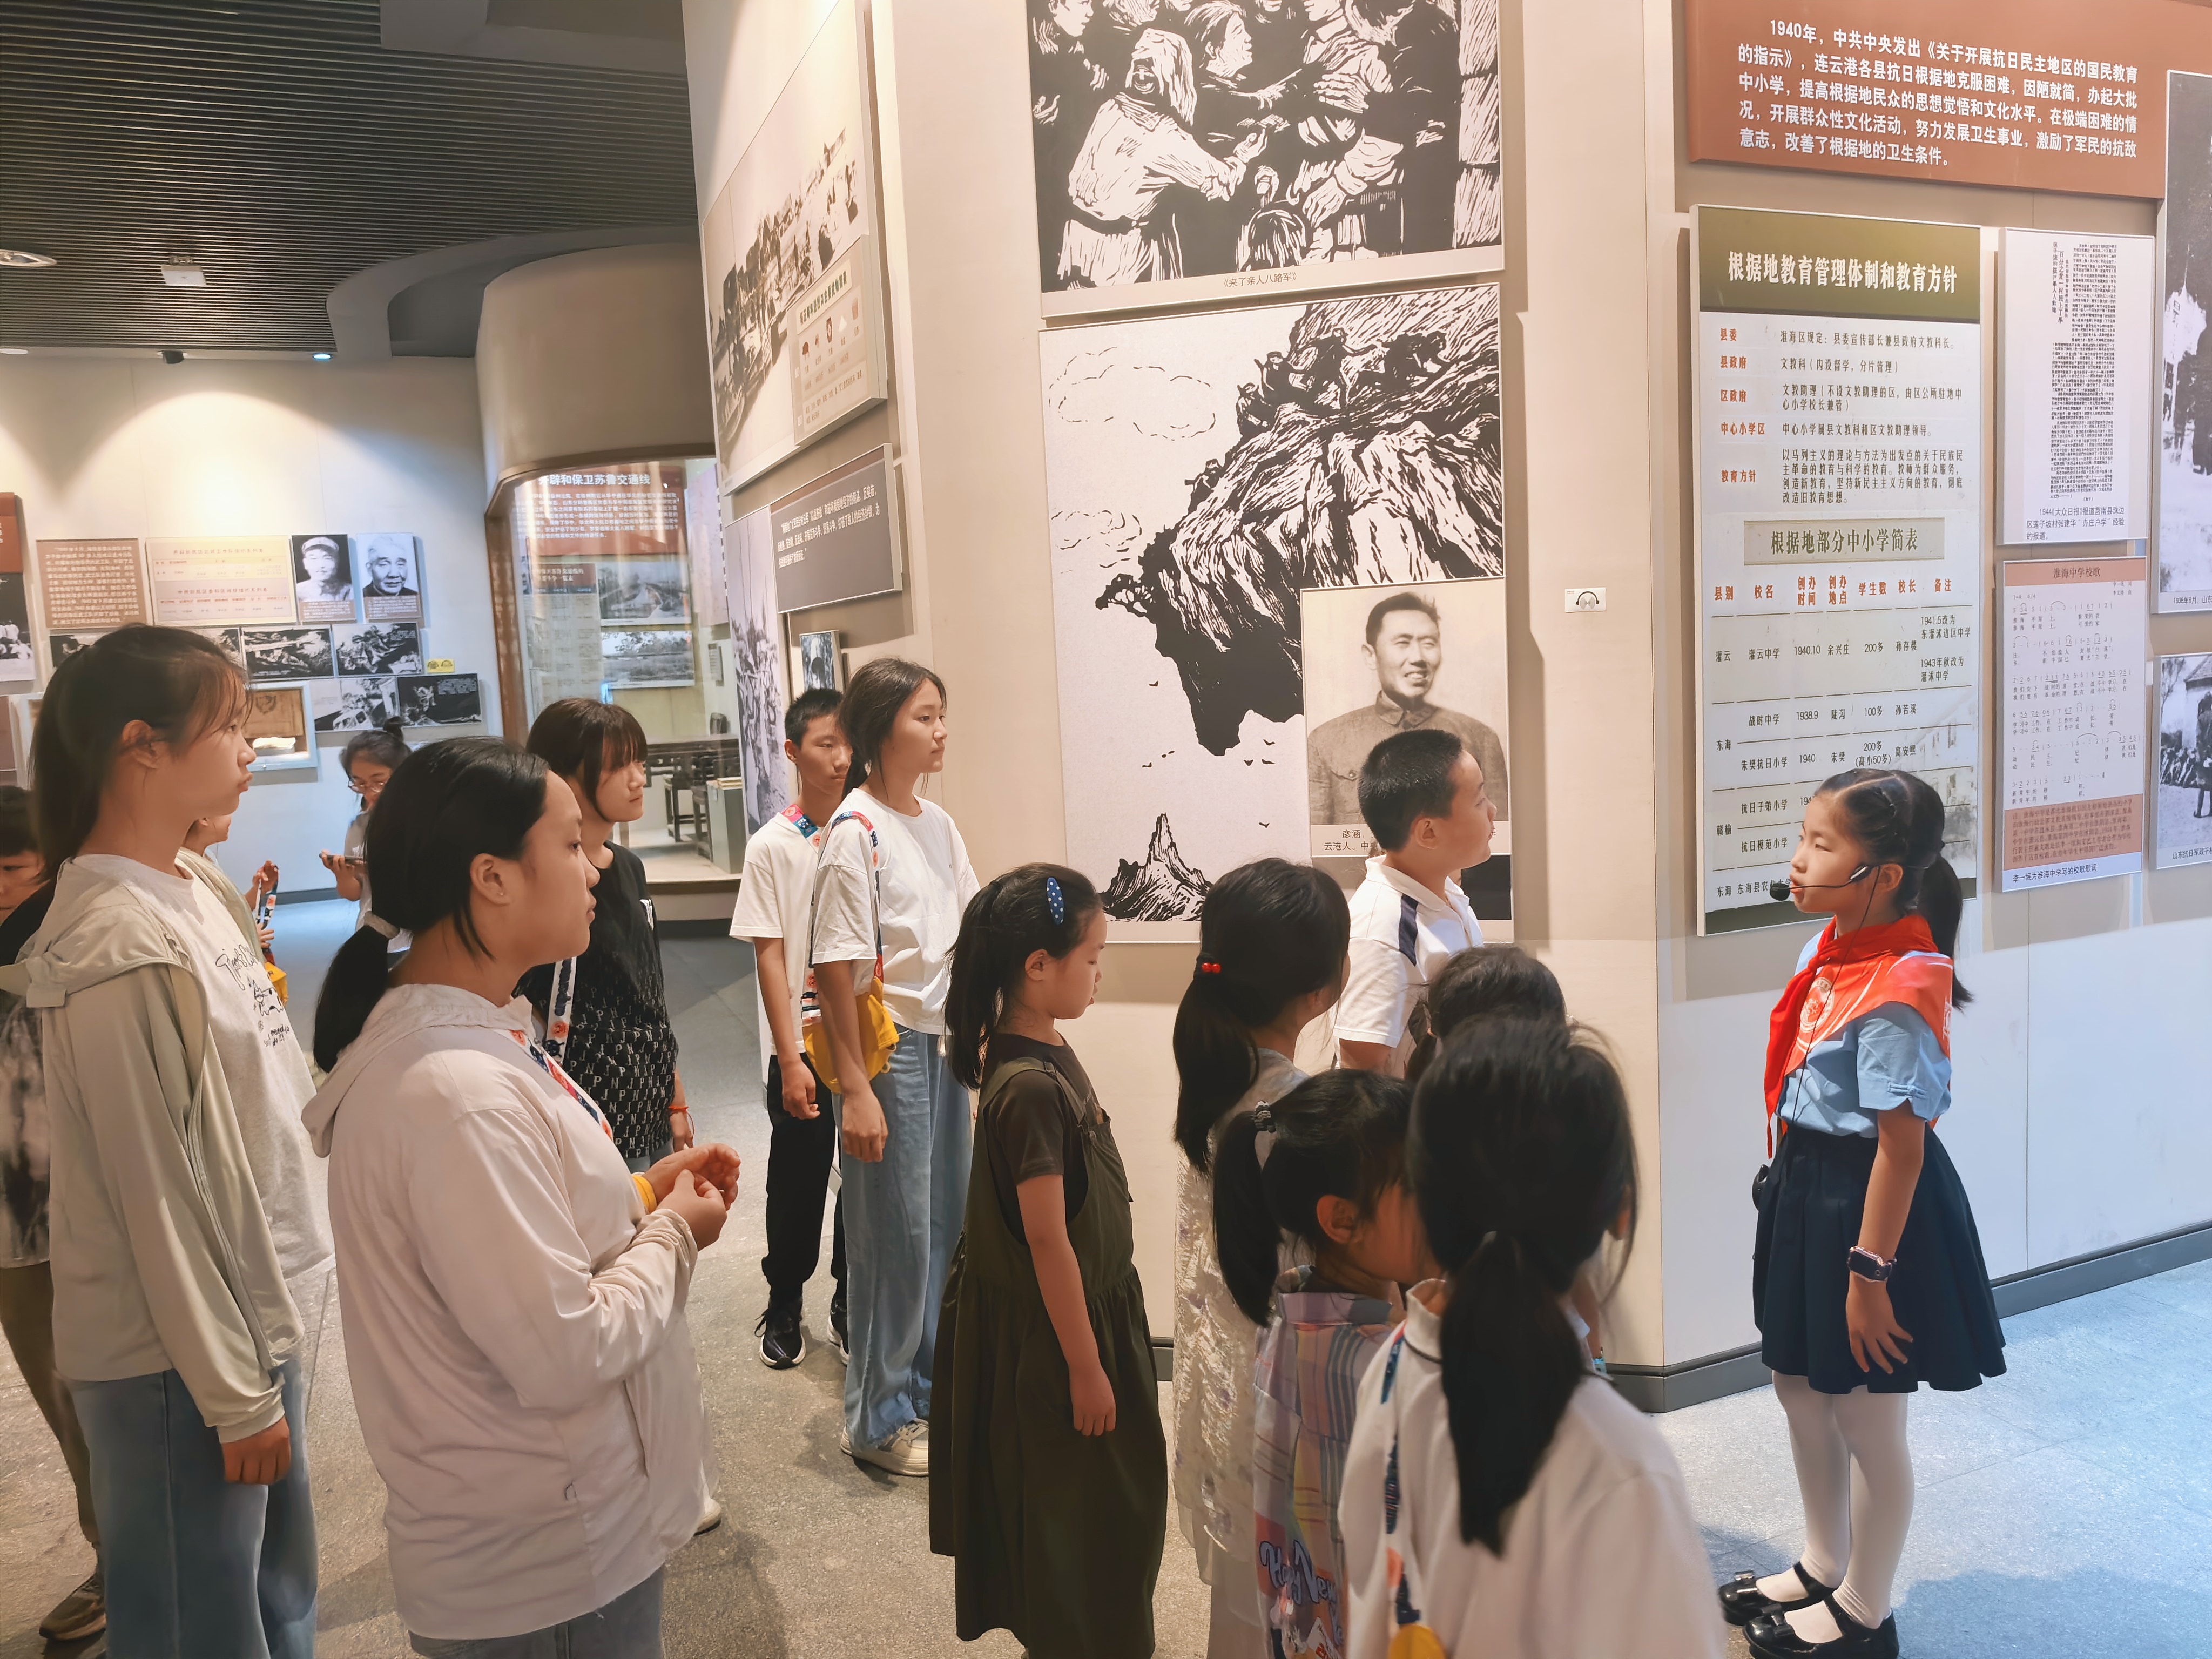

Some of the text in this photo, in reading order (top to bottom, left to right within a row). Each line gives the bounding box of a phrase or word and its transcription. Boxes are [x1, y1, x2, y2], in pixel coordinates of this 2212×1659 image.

[1770, 19, 2138, 84] 1940年，中共中央发出《关于开展抗日民主地区的国民教育
[1738, 43, 2137, 109] 的指示》，连云港各县抗日根据地克服困难，因陋就简，办起大批
[1739, 71, 2137, 134] 中小学，提高根据地民众的思想觉悟和文化水平。在极端困难的情
[1739, 100, 2137, 158] 况，开展群众性文化活动，努力发展卫生事业，激励了军民的抗敌
[1739, 127, 1948, 166] 意志，改善了根据地的卫生条件。
[1224, 272, 1297, 288] 《来了亲人八路军》
[1728, 251, 1957, 293] 根据地教育管理体制和教育方针
[1720, 328, 1737, 341] 县委
[1721, 355, 1898, 373] 县政府 文教科（内设督学，分片管理）
[1721, 389, 1746, 403] 区政府
[1782, 397, 1849, 412] 心小学校长兼管）
[1721, 422, 1765, 435] 中心小学区
[1783, 449, 1963, 461] 以马列主义的理论与方法为出发点的关于民族民
[1721, 469, 1756, 483] 教育方针
[1783, 491, 1847, 504] 改造旧教育思想。
[1771, 528, 1918, 555] 根据地部分中小学简表
[2054, 566, 2101, 579] 淮海中学校歌
[1715, 575, 1952, 601] 县别 校名 创办 创办 学生数 校长 备注
[1798, 590, 1847, 606] 时间 地点
[1716, 650, 1731, 663] 灌云
[1749, 648, 1779, 660] 灌云中学
[1794, 645, 1820, 656] 1940.10
[1827, 644, 1850, 656] 余兴庄
[1864, 642, 1884, 652] 200多
[1920, 656, 1964, 667] 1943年秋改为
[1749, 713, 1779, 726] 战时中学
[1796, 711, 1818, 720] 1938.9
[1865, 706, 1883, 717] 100多
[1895, 704, 1916, 715] 孙若溪
[1716, 739, 1731, 751] 东海
[1863, 740, 1882, 752] 200多
[1741, 756, 1788, 771] 朱樊抗日小学
[1799, 754, 1816, 763] 1940
[1831, 751, 1845, 763] 朱樊
[1741, 796, 1816, 814] 抗日子弟小学 194
[1717, 824, 1731, 836] 赣榆
[1324, 841, 1375, 851] 云港人。中
[1741, 837, 1788, 853] 抗日模范小学
[1717, 885, 1731, 898] 东海
